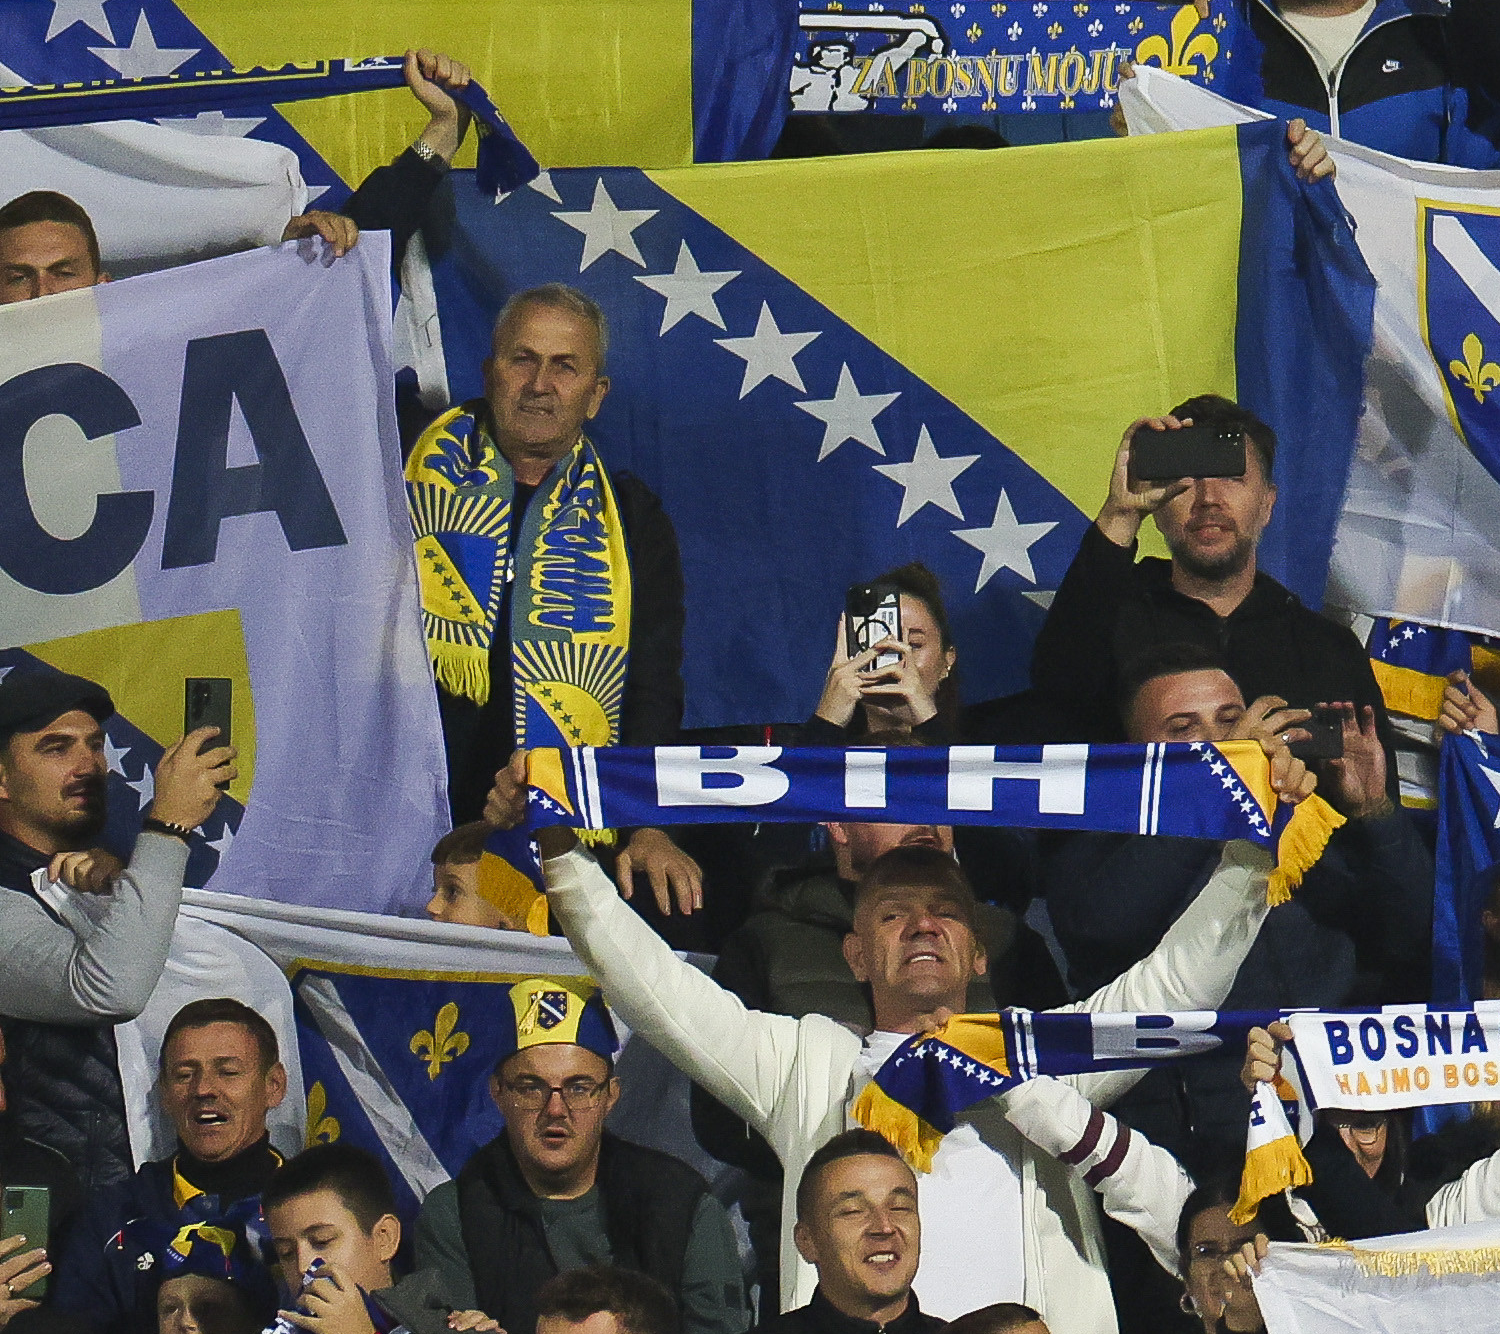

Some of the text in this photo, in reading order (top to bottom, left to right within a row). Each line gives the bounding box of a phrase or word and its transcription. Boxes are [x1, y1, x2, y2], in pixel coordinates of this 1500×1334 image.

[907, 54, 1020, 100] BOSNU
[1324, 1013, 1488, 1065] BOSNA
[1336, 1066, 1430, 1095] HAJMO
